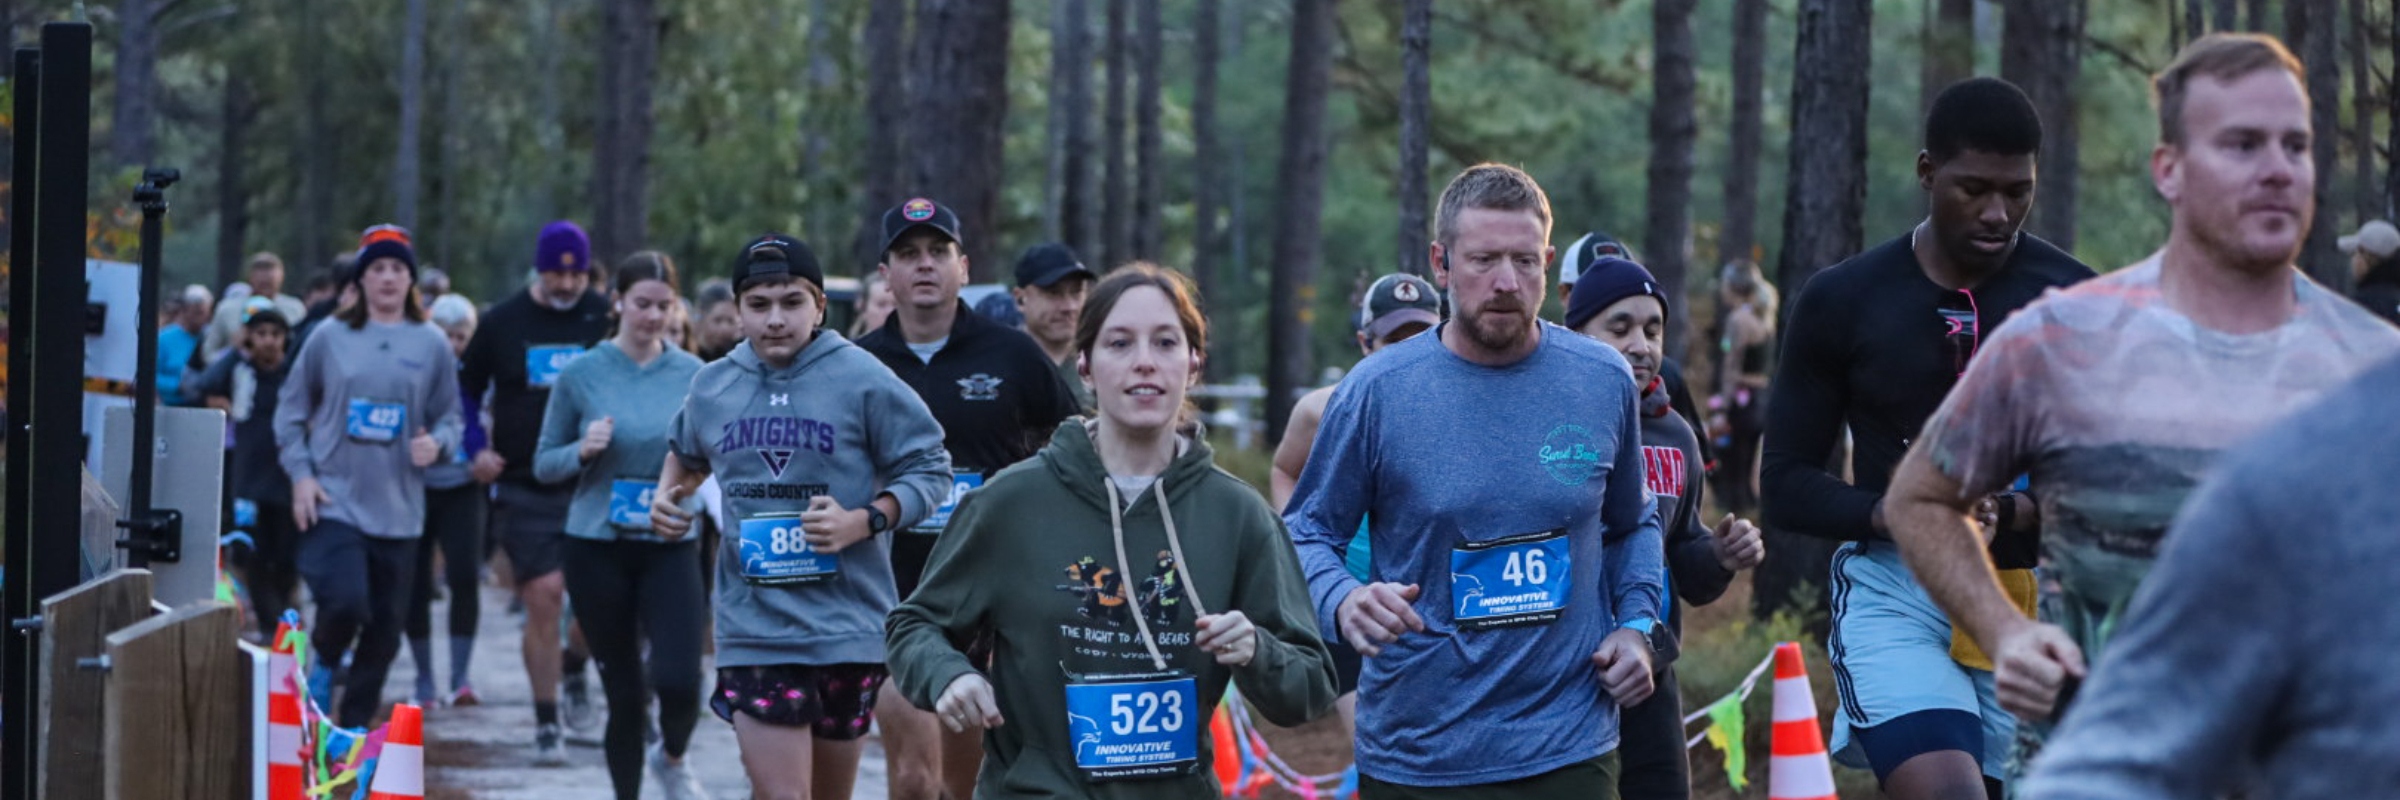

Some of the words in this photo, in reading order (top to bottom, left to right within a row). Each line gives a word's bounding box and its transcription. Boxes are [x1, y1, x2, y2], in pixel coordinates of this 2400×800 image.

[721, 416, 835, 455] KNIGHTS
[1640, 446, 1685, 498] AND
[727, 483, 765, 499] CROSS
[768, 483, 829, 501] COUNTRY
[770, 526, 817, 555] 88
[1502, 548, 1547, 587] 46
[1479, 591, 1549, 607] INNOVATIVE
[1060, 624, 1081, 638] THE
[1084, 627, 1115, 644] RIGHT
[1118, 632, 1131, 643] TO
[1158, 632, 1191, 646] BEARS
[1075, 646, 1108, 657] CODY
[1121, 652, 1174, 660] WYOMG
[1111, 689, 1183, 736] 523
[1095, 740, 1172, 756] INNOVATIVE
[1105, 755, 1136, 764] TIMING
[1138, 752, 1176, 762] SYSTEMS
